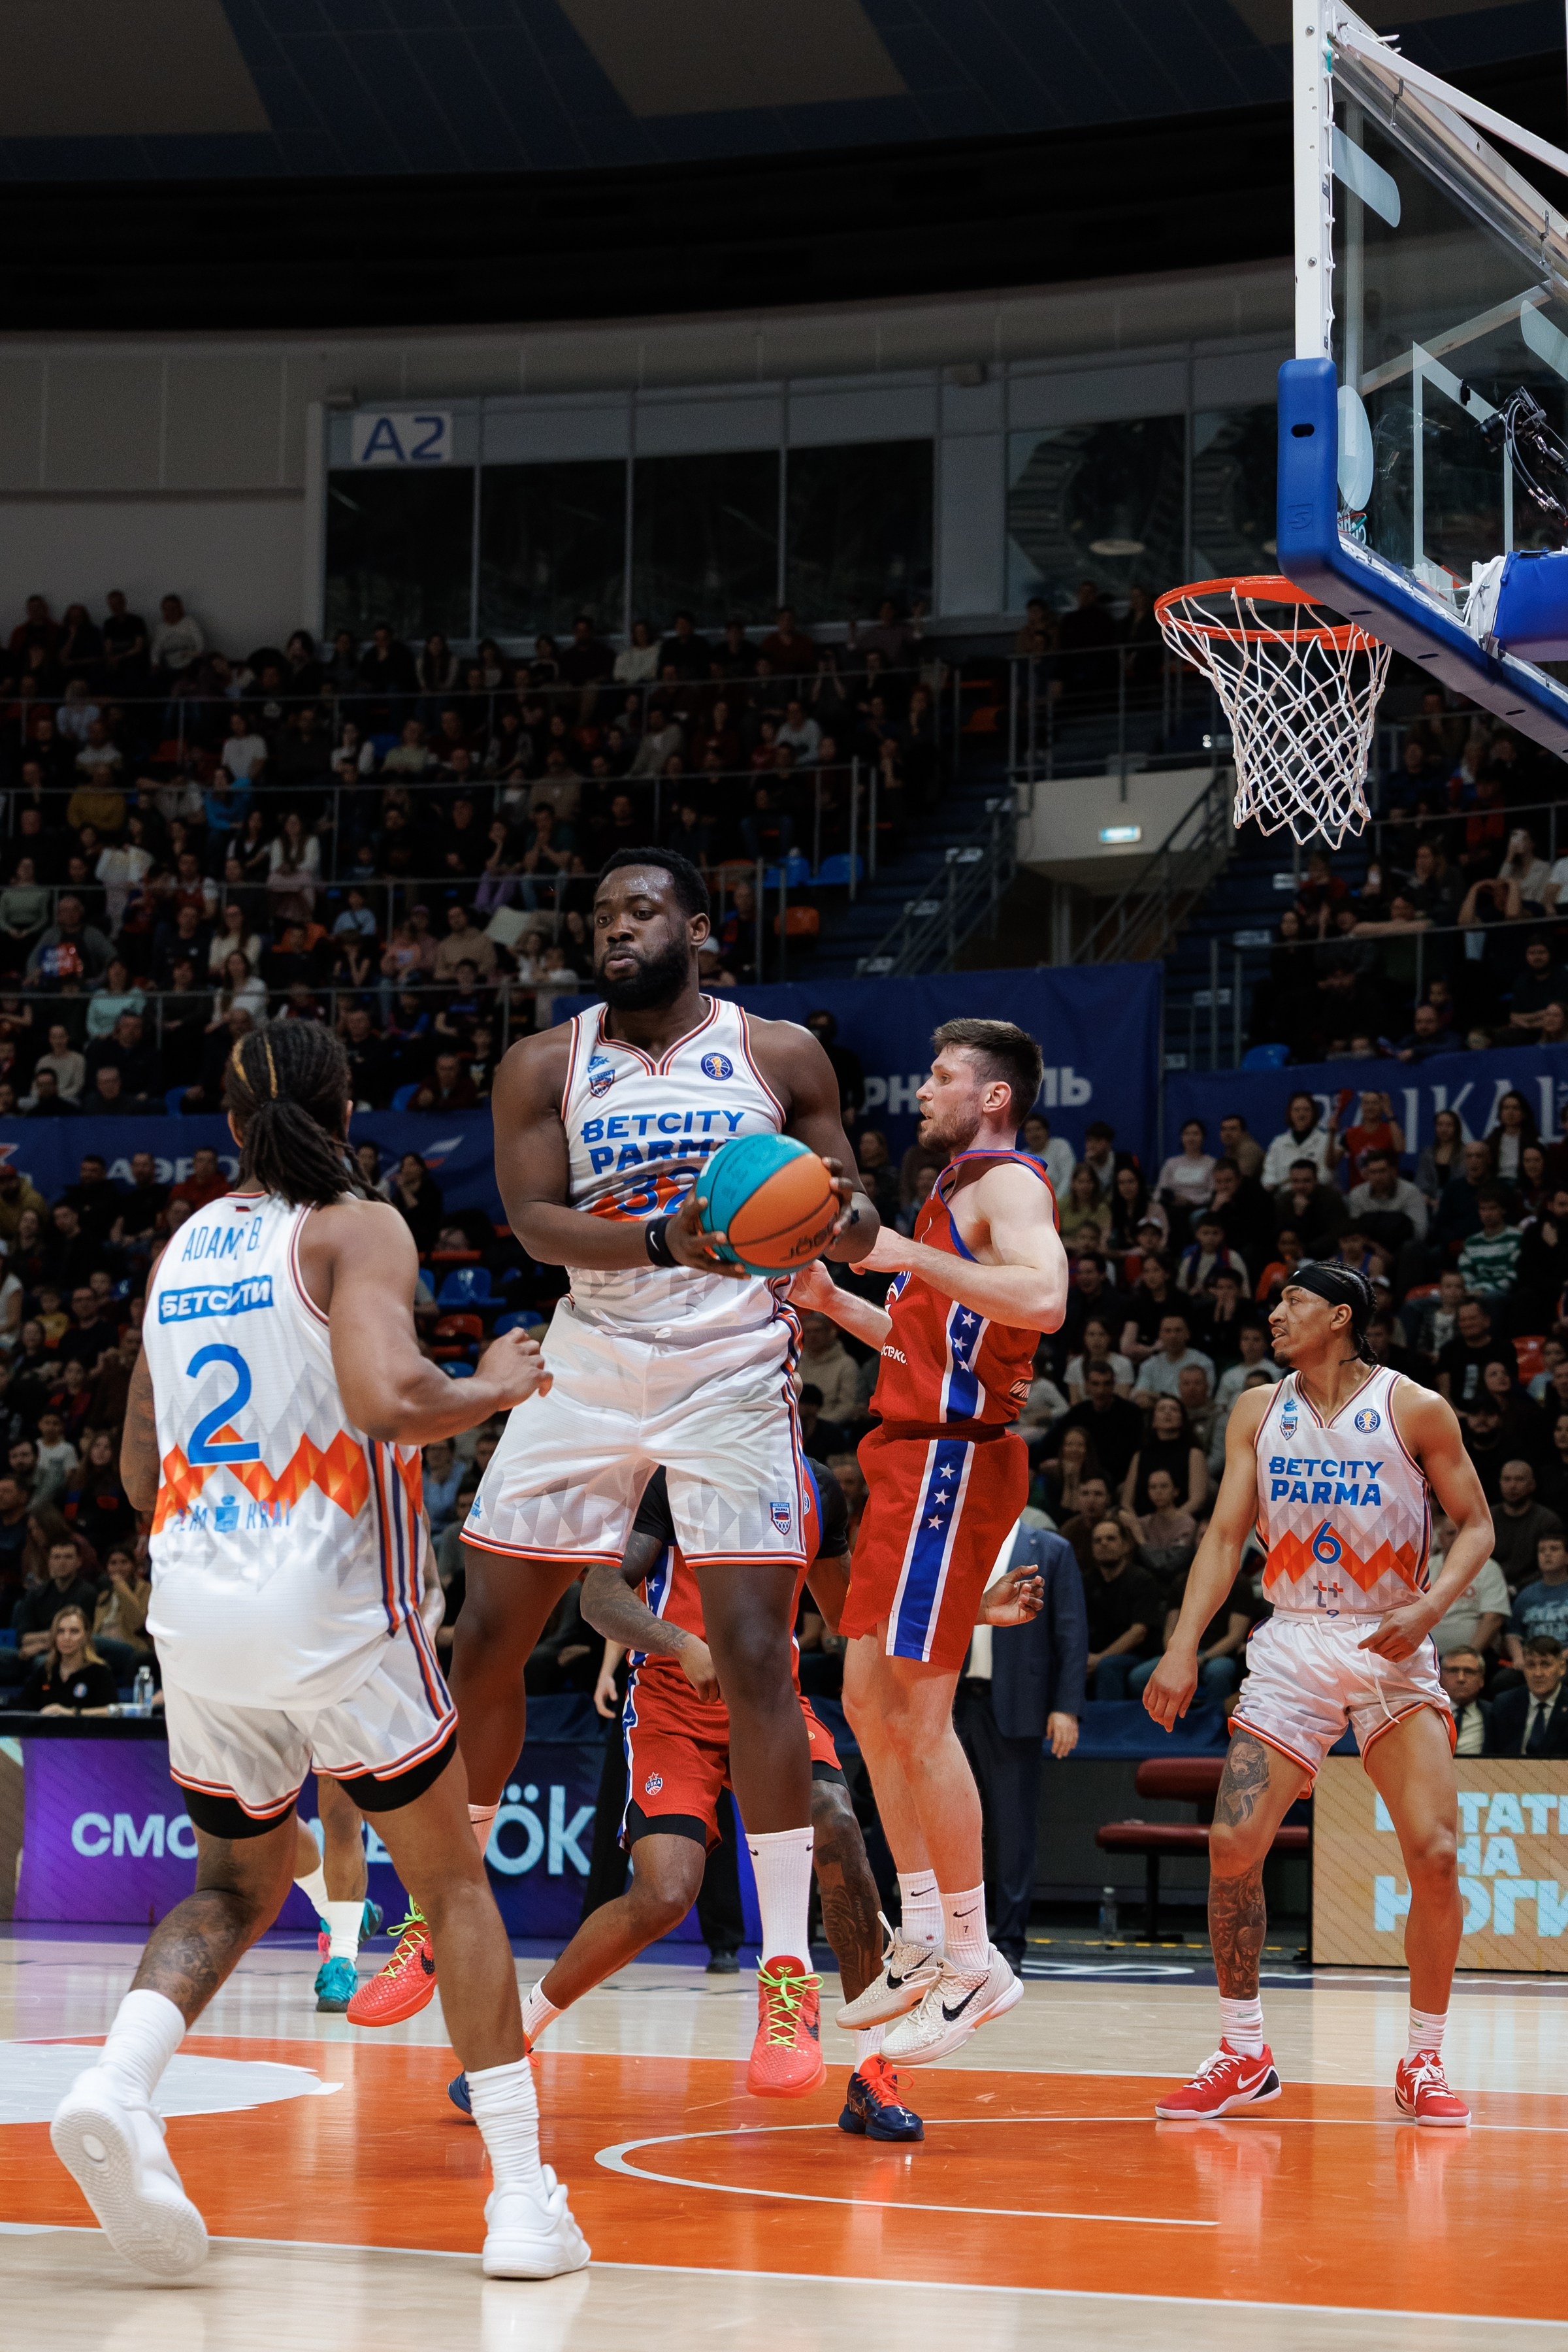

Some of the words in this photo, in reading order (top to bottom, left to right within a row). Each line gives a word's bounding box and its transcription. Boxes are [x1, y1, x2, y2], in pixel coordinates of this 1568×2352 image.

[363, 416, 444, 461] A2
[580, 1109, 745, 1144] BETCITY
[588, 1138, 736, 1175] PARM
[616, 1166, 700, 1217] 32
[182, 1220, 249, 1261] ADAM
[186, 1343, 261, 1465] 2
[1269, 1456, 1384, 1478] BETCITY
[1271, 1478, 1382, 1506] PARMA
[1313, 1522, 1342, 1564] 6
